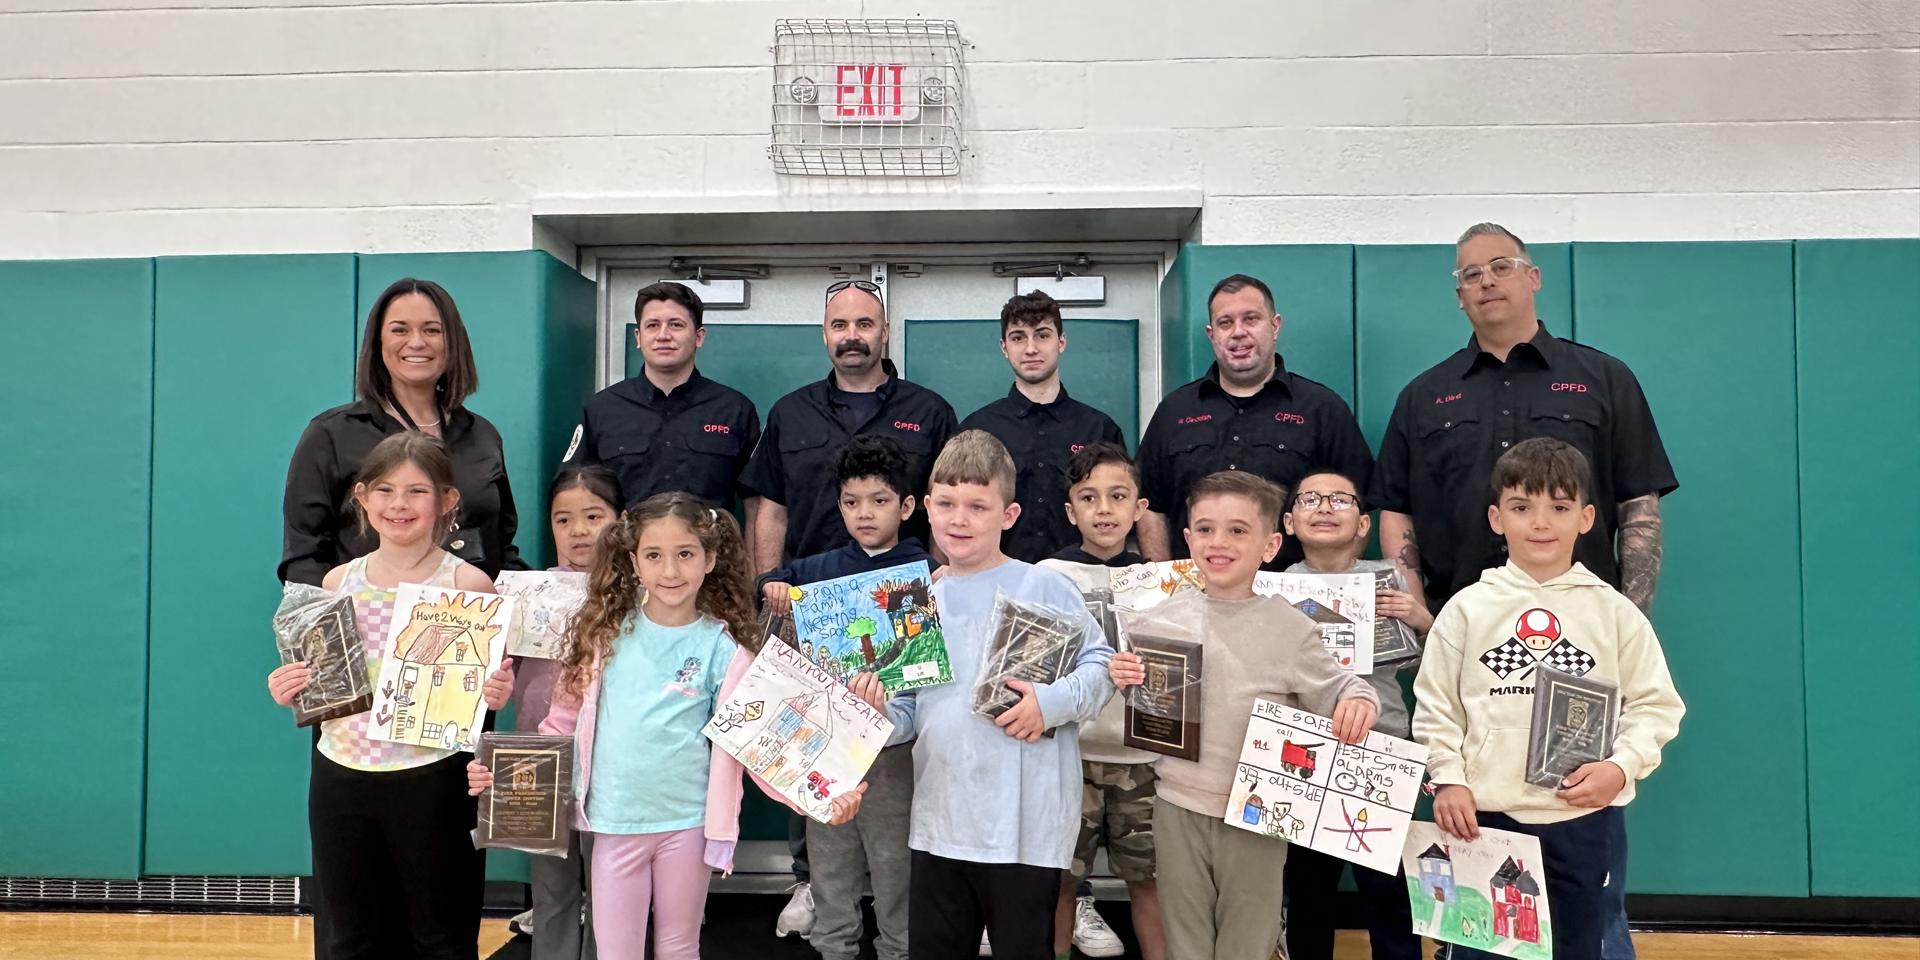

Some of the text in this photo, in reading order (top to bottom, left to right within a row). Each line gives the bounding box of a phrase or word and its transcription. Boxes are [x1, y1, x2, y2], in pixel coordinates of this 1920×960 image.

[836, 64, 905, 116] EXIT
[1551, 383, 1587, 392] CPFD
[1275, 412, 1304, 424] CPFD
[704, 424, 730, 433] CPFD
[895, 421, 920, 431] CPFD
[1276, 578, 1293, 593] to
[416, 611, 440, 622] Have
[440, 611, 448, 622] 2
[449, 614, 471, 626] Ways
[771, 639, 807, 670] PLAN
[841, 691, 886, 731] ESCAPE
[1257, 703, 1283, 719] FIRE
[1276, 728, 1294, 738] call
